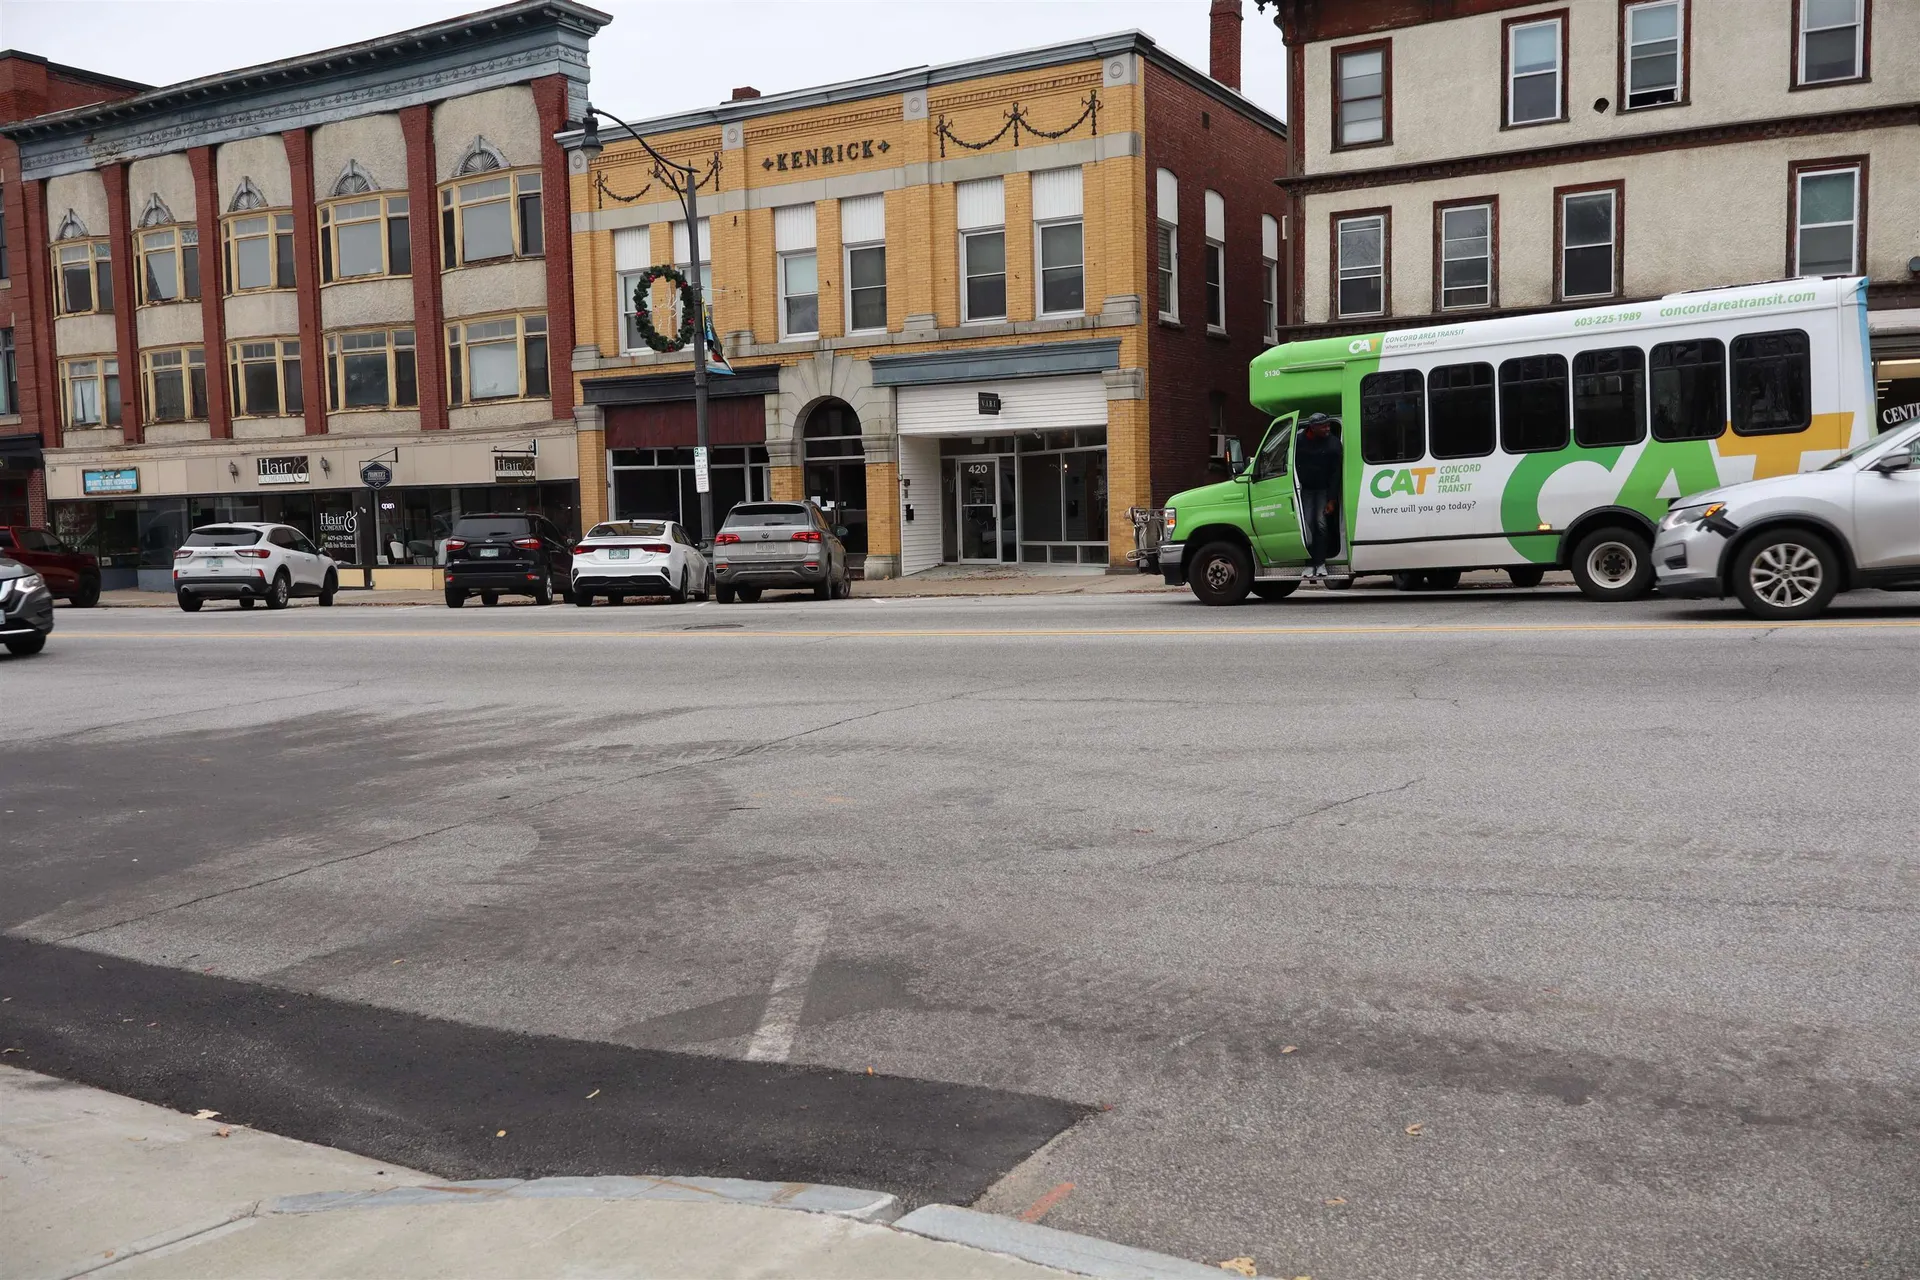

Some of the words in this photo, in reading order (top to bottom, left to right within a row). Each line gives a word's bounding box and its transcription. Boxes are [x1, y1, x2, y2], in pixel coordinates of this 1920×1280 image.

[776, 139, 874, 171] KENRICK
[1659, 291, 1816, 318] concordareatransit.com
[1574, 311, 1642, 327] 603-225-1989
[1385, 334, 1418, 343] CONCORD
[1419, 332, 1437, 340] AREA
[1437, 329, 1465, 337] TRANSIT
[1348, 337, 1381, 354] CAT
[259, 458, 292, 475] Hair
[497, 459, 522, 471] Hair
[968, 464, 988, 474] 420
[1440, 463, 1482, 475] CONCORD
[1370, 466, 1436, 499] CAT
[1438, 474, 1460, 484] AREA
[1438, 483, 1472, 494] TRANSIT
[1371, 506, 1398, 515] Where
[1400, 504, 1416, 513] will
[1418, 504, 1434, 514] you
[1436, 504, 1446, 513] go
[1448, 501, 1477, 512] today?
[320, 512, 344, 525] Hair
[344, 511, 358, 533] &
